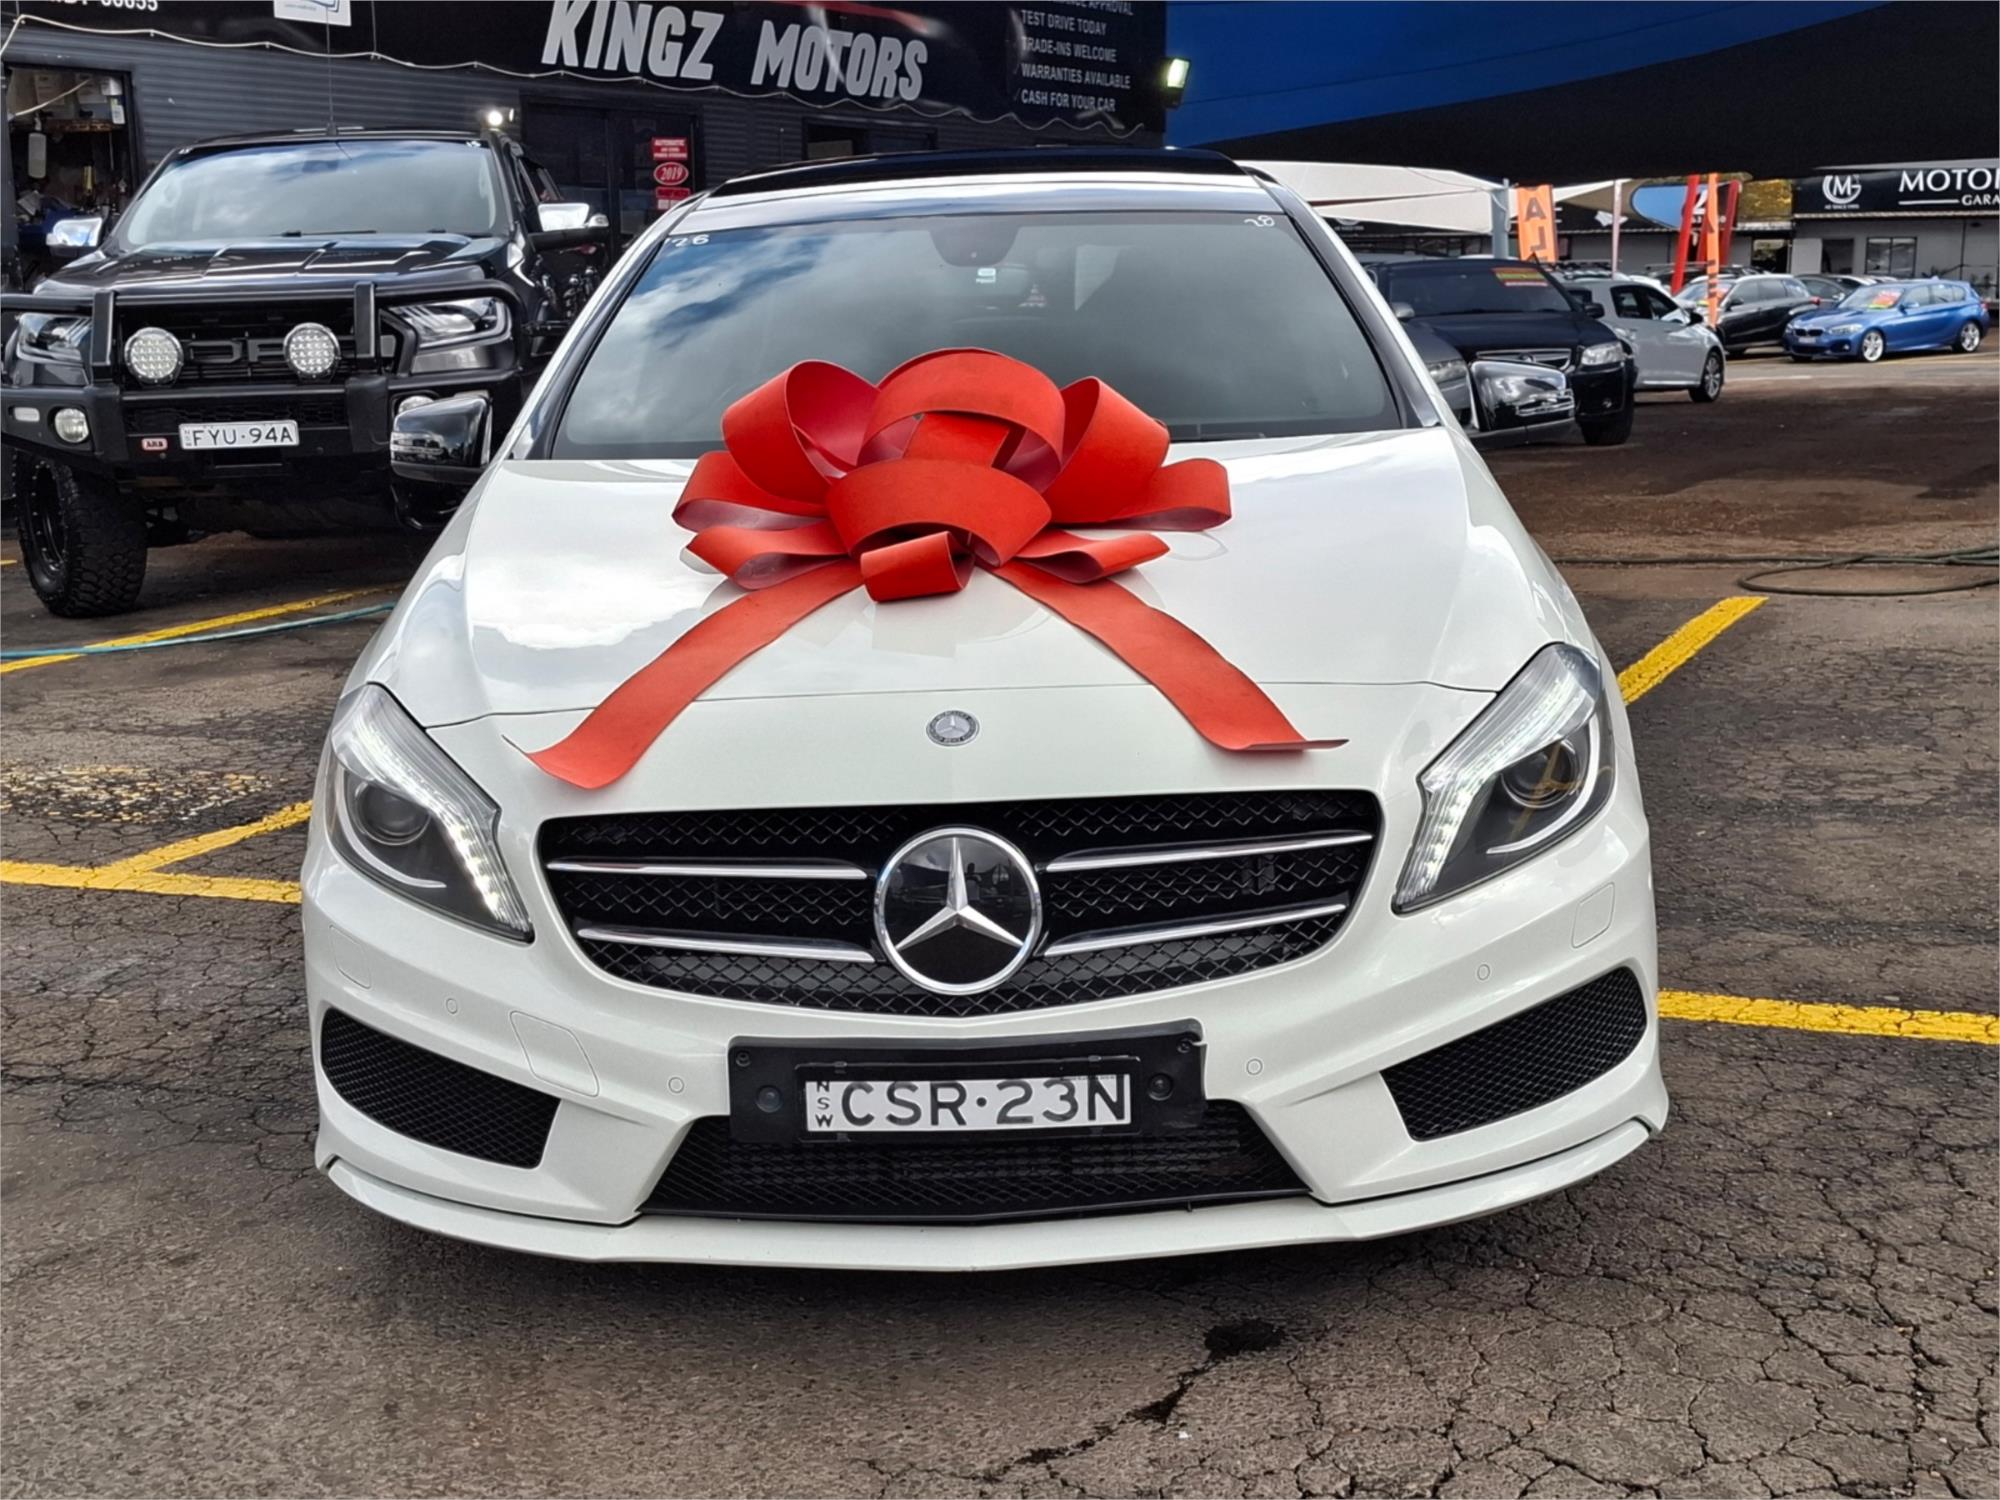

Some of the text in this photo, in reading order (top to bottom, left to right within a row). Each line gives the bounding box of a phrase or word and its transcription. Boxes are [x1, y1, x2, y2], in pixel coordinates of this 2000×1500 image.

[1021, 9, 1107, 36] TEST DRIVE TODAY
[541, 0, 929, 100] KINGZ MOTORS
[1021, 36, 1117, 63] TRADE-INS WELCOME
[1021, 63, 1131, 89] WARRANTIES AVAILABLE
[1021, 89, 1116, 112] CASH FOR YOUR CAR
[661, 167, 683, 181] 2019
[1898, 168, 2000, 192] MOTO
